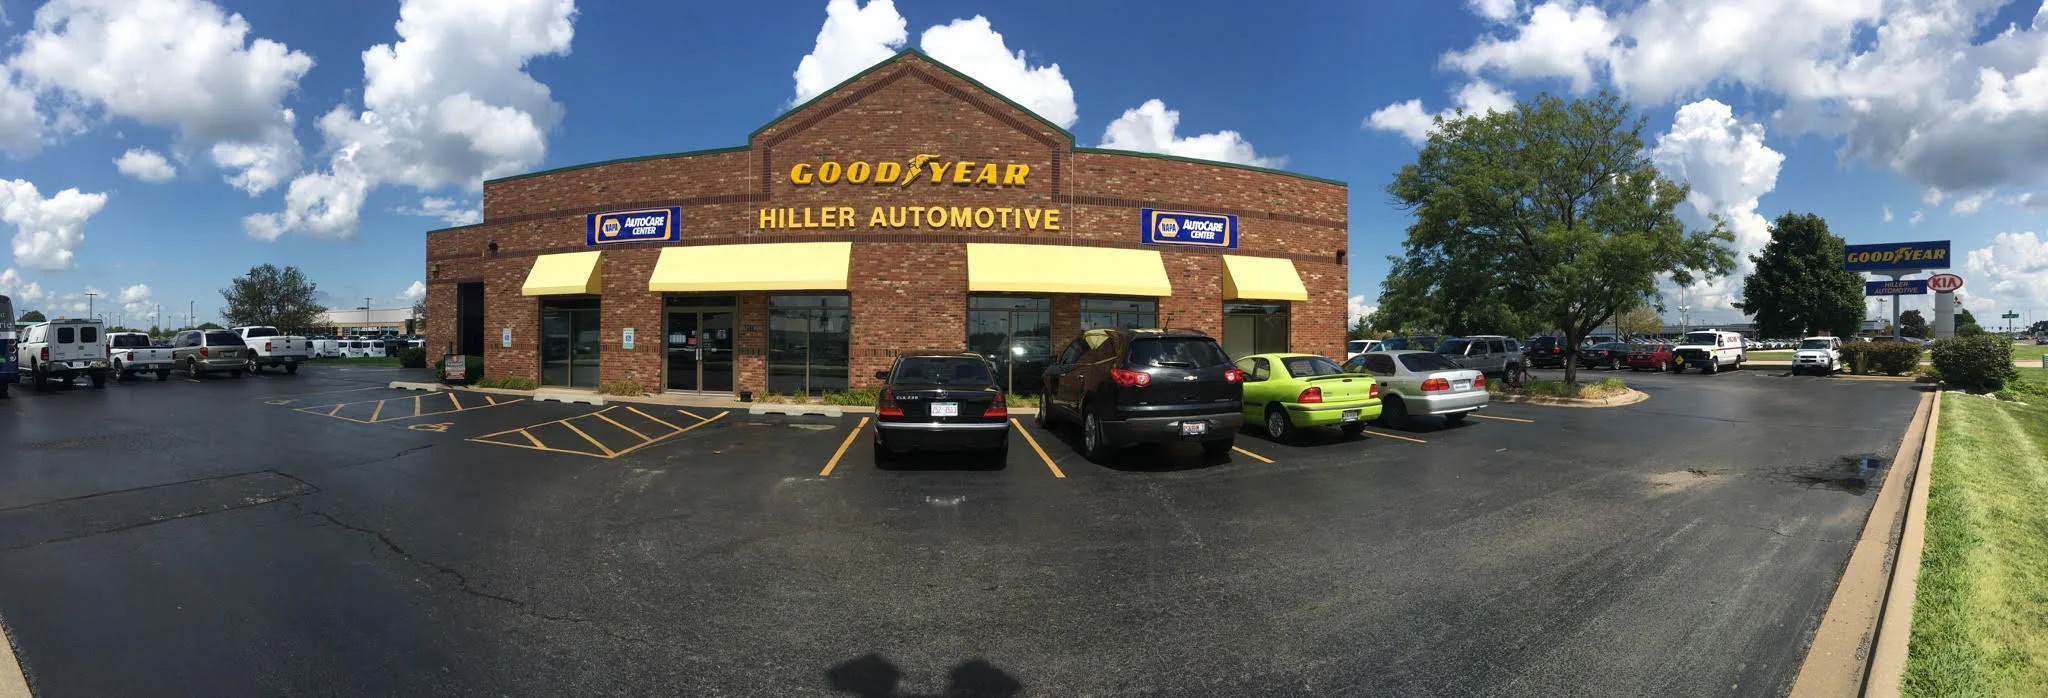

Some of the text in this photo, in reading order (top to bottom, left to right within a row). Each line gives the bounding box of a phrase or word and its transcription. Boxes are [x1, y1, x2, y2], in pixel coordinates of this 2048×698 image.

[759, 206, 1060, 231] HILLER AUTOMOTIVE
[605, 223, 618, 233] NAPA
[632, 226, 656, 235] CENTER
[1161, 223, 1177, 233] NAPA
[1190, 231, 1215, 240] CENTER
[1932, 277, 1957, 288] KIA
[1874, 287, 1919, 295] AUTOMOTIVE
